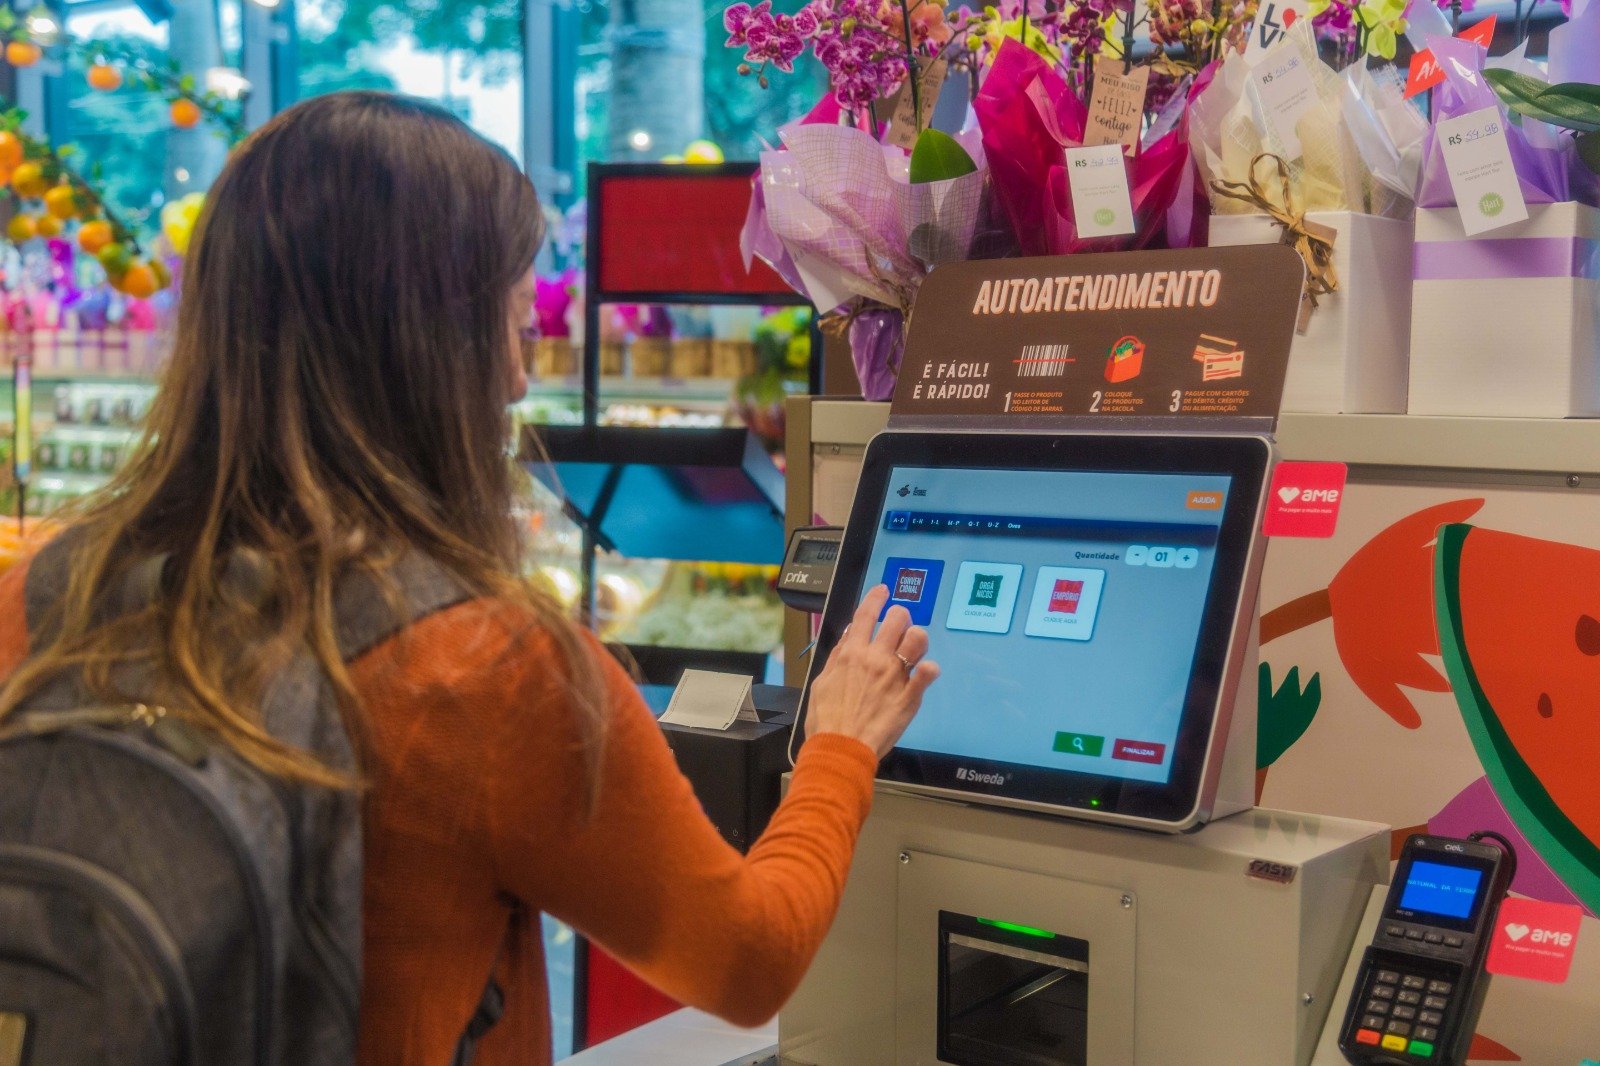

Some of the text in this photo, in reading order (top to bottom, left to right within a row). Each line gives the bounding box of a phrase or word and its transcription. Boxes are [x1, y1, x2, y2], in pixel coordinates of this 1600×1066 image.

[1100, 76, 1119, 88] MEU
[1262, 72, 1274, 84] R$
[1103, 96, 1132, 117] FELIZ
[1095, 115, 1132, 138] contigo
[1448, 133, 1463, 146] R$
[1075, 160, 1087, 168] R$
[972, 269, 1222, 315] AUTOATENDIMENTO
[923, 360, 990, 379] É FÁCIL!
[913, 380, 990, 399] É RÁPIDO!
[1221, 389, 1249, 397] CARTÕES
[1003, 391, 1012, 413] 1
[1089, 391, 1102, 412] 2
[1169, 390, 1182, 412] 3
[1192, 496, 1216, 504] AJUDA
[1074, 551, 1168, 562] Quantidade 01
[784, 570, 809, 584] prix
[900, 576, 922, 586] CONVEN
[899, 584, 919, 594] CIONAL
[976, 590, 994, 599] NICOS
[1052, 590, 1081, 601] EMPÓRIO
[1122, 746, 1155, 757] FINALIZAR
[967, 769, 1005, 786] Sweda
